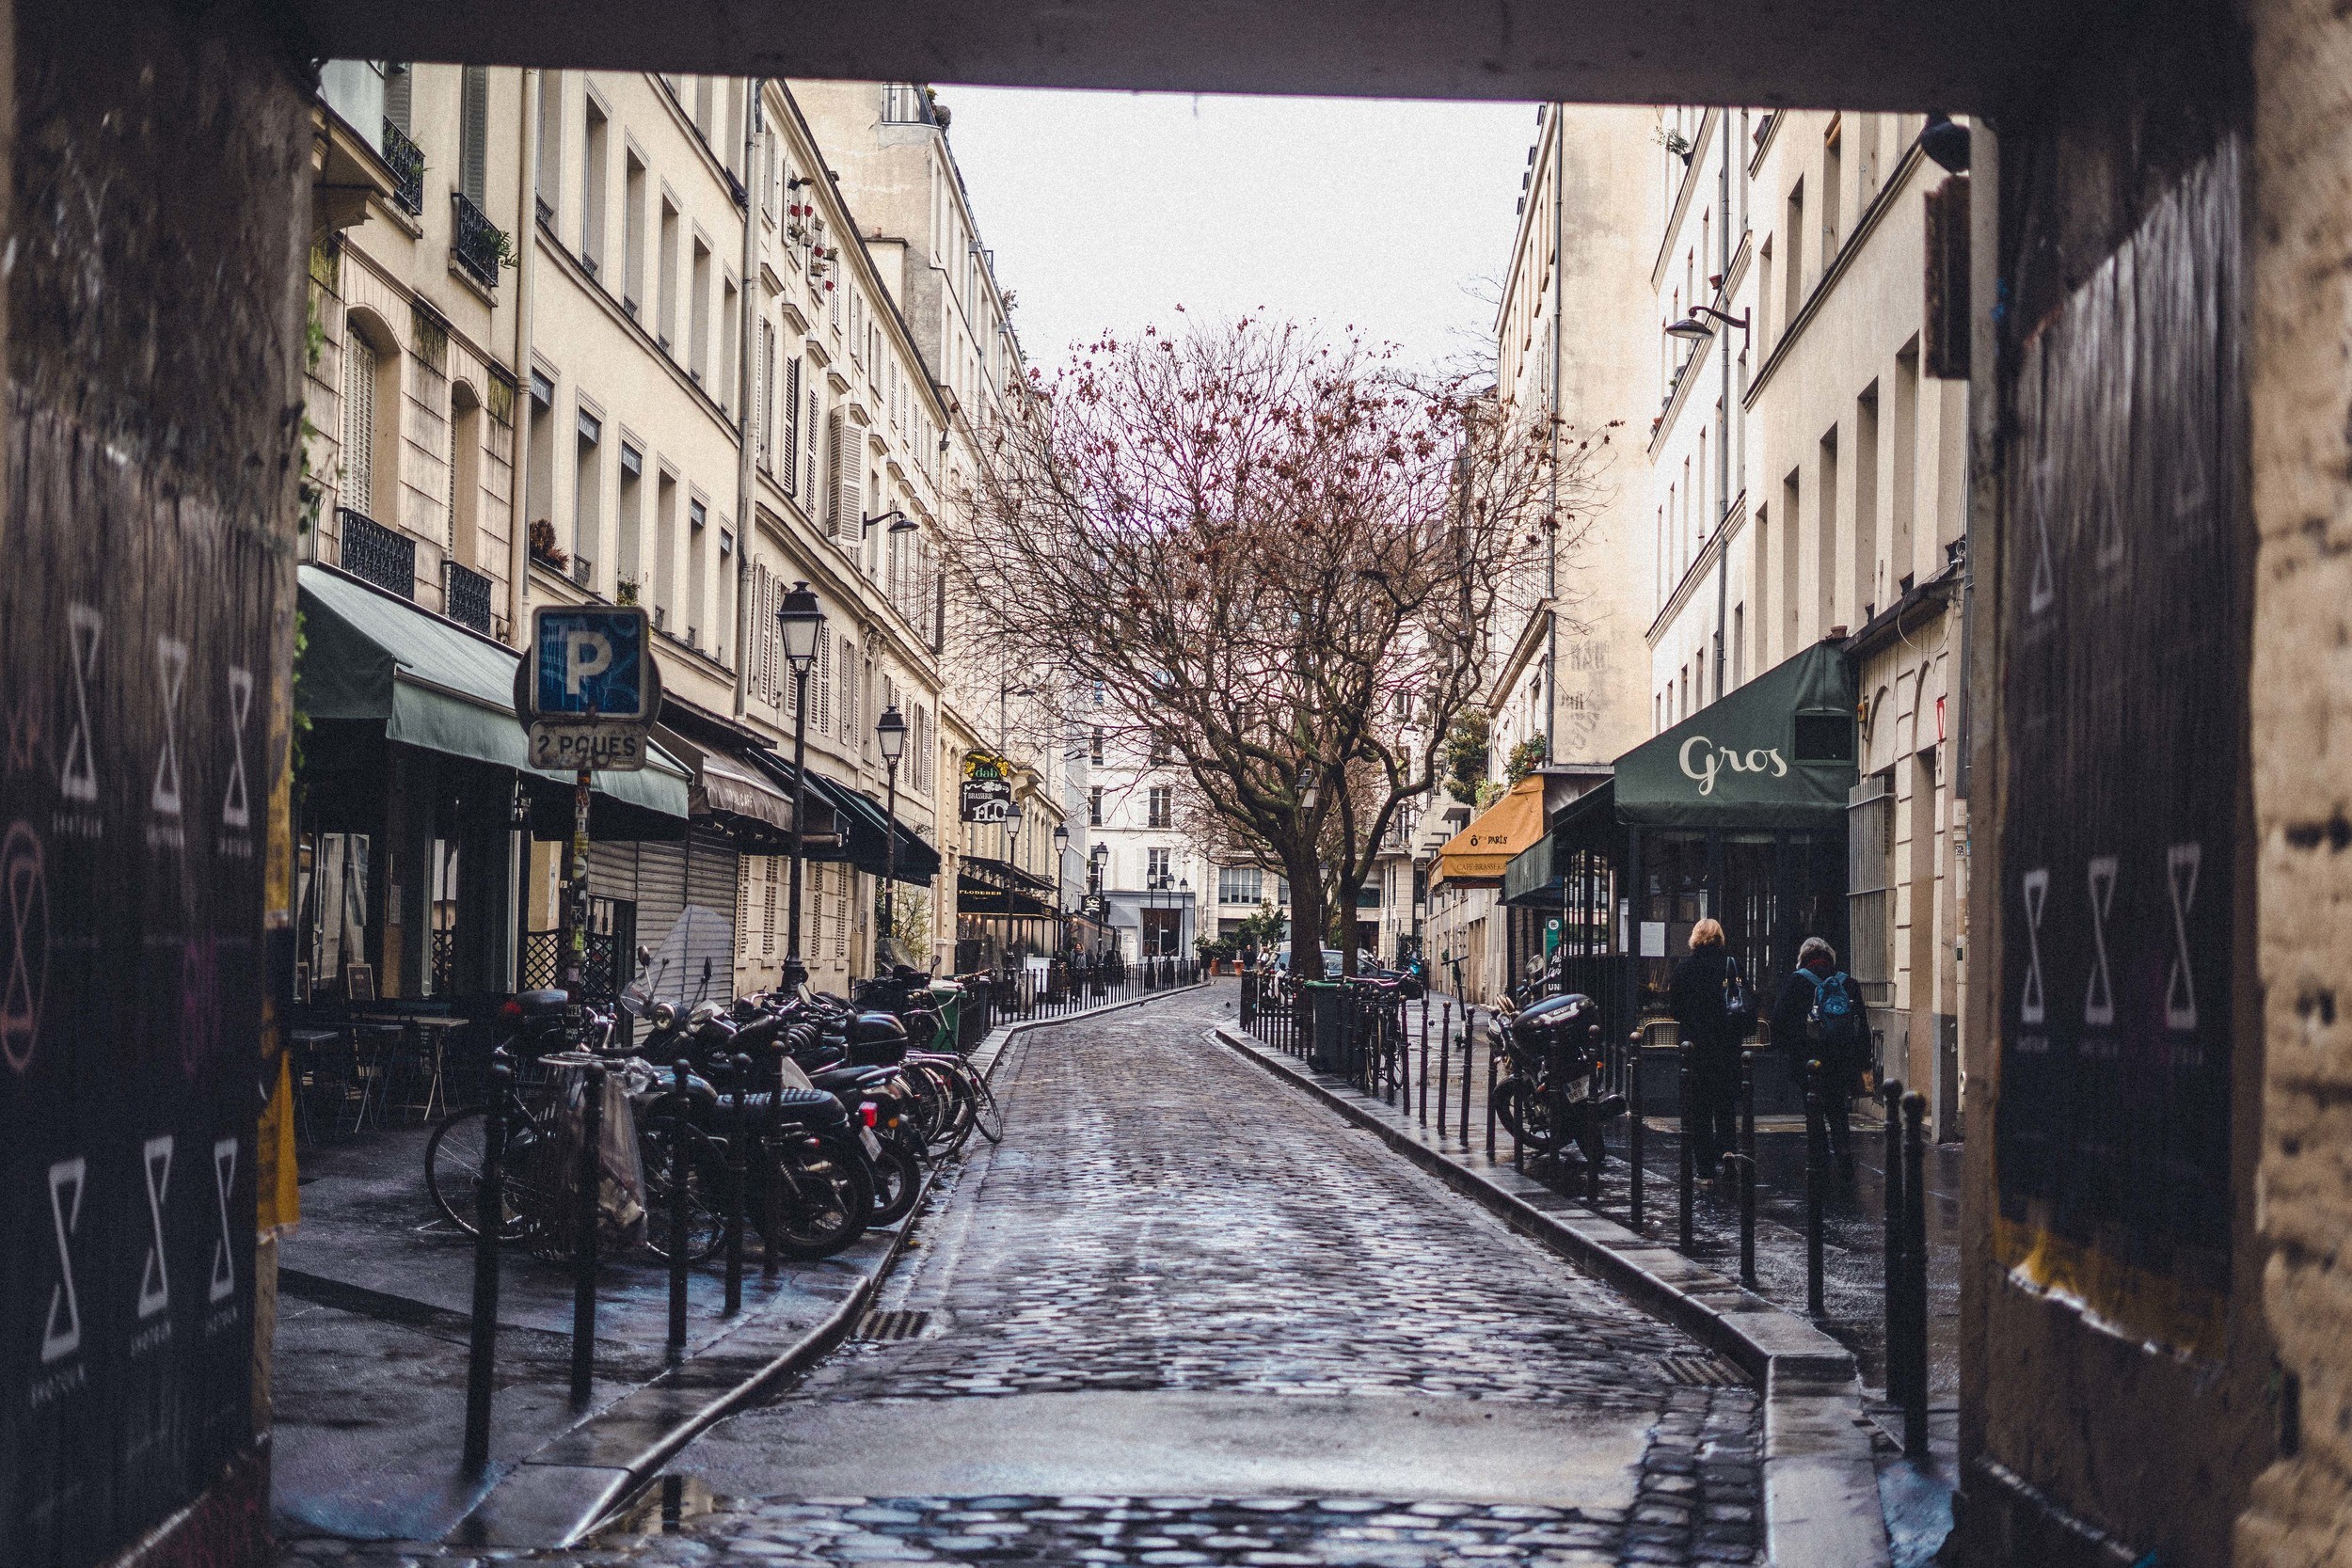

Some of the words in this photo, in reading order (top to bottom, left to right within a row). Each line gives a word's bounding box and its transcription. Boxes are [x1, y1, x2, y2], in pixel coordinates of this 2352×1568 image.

[566, 631, 612, 695] P
[538, 735, 550, 753] 2
[975, 768, 998, 778] dab
[1679, 736, 1788, 796] Gros
